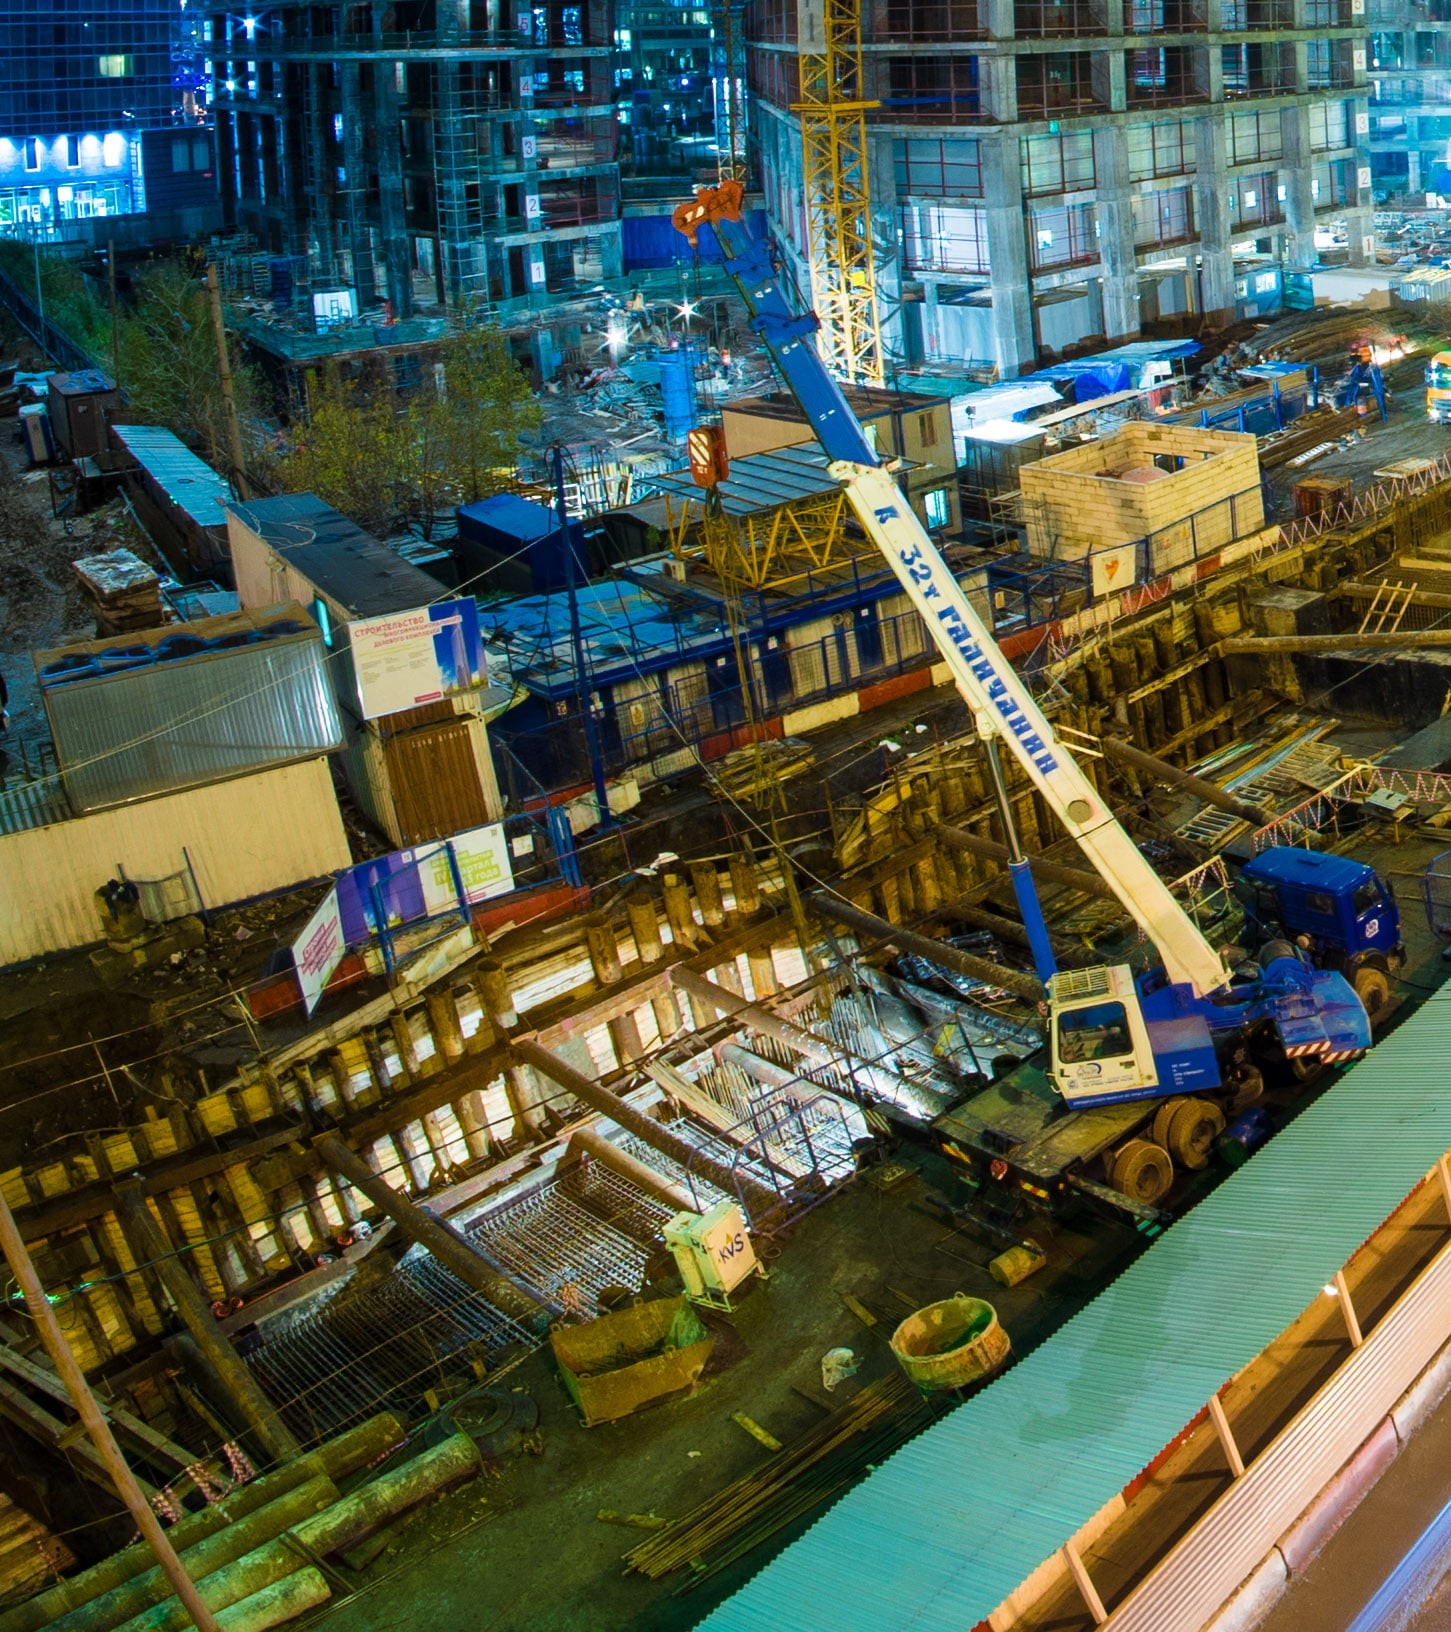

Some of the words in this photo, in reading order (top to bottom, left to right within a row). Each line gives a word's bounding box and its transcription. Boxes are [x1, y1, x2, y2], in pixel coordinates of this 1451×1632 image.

[1355, 51, 1363, 66] 4
[522, 79, 530, 94] 4
[1359, 115, 1367, 131] 3
[525, 140, 533, 156] 3
[1361, 170, 1369, 186] 2
[529, 198, 537, 212] 2
[354, 616, 425, 638] СТРОИТЕЛЬСТВО
